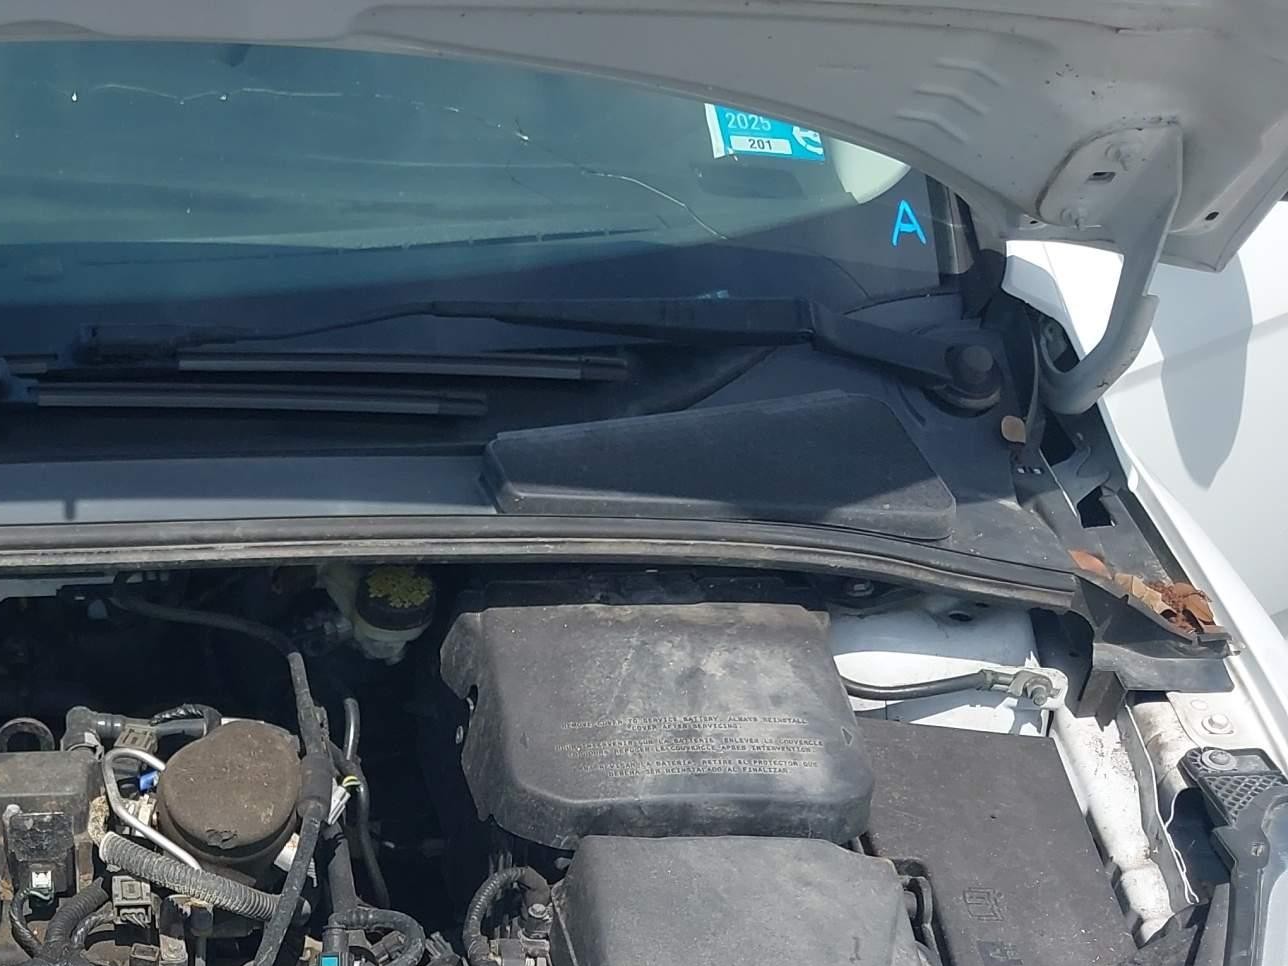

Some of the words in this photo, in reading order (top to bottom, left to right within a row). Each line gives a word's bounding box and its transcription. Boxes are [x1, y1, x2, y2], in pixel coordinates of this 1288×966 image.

[725, 112, 773, 132] 2025
[748, 138, 773, 151] 201
[891, 199, 927, 248] A
